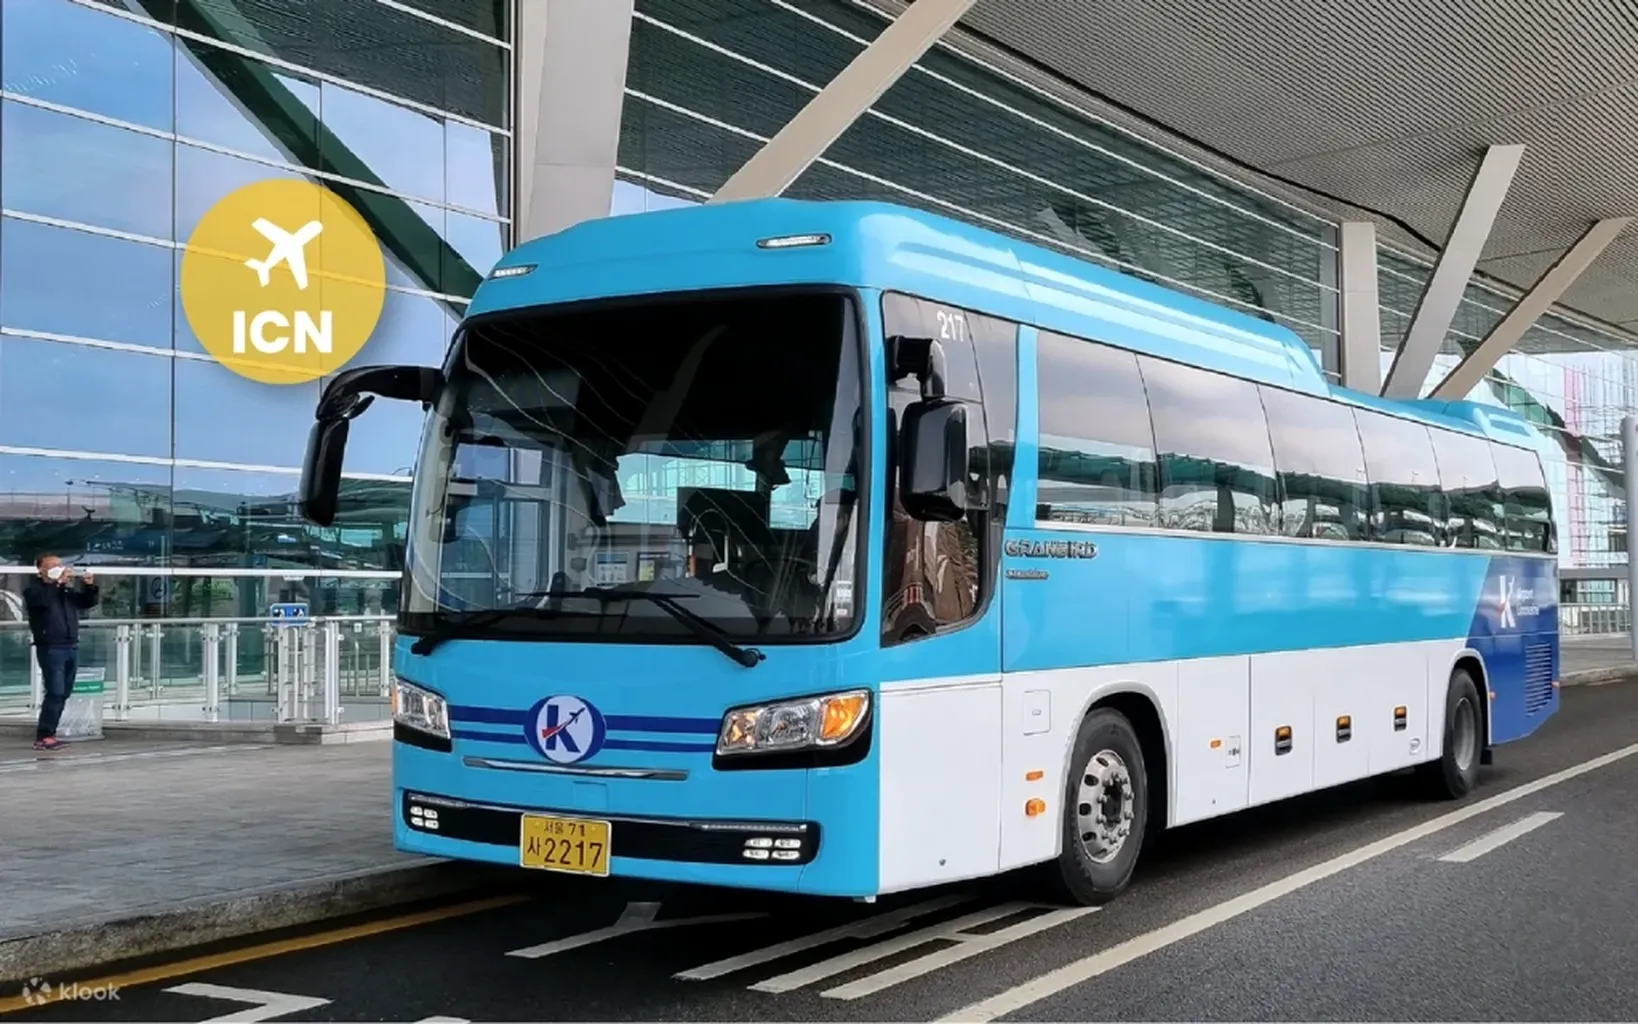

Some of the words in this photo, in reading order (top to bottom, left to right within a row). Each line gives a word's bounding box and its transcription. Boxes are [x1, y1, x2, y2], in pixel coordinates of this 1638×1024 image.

[936, 310, 964, 342] 217
[544, 821, 564, 835] 서울
[568, 822, 586, 837] 71
